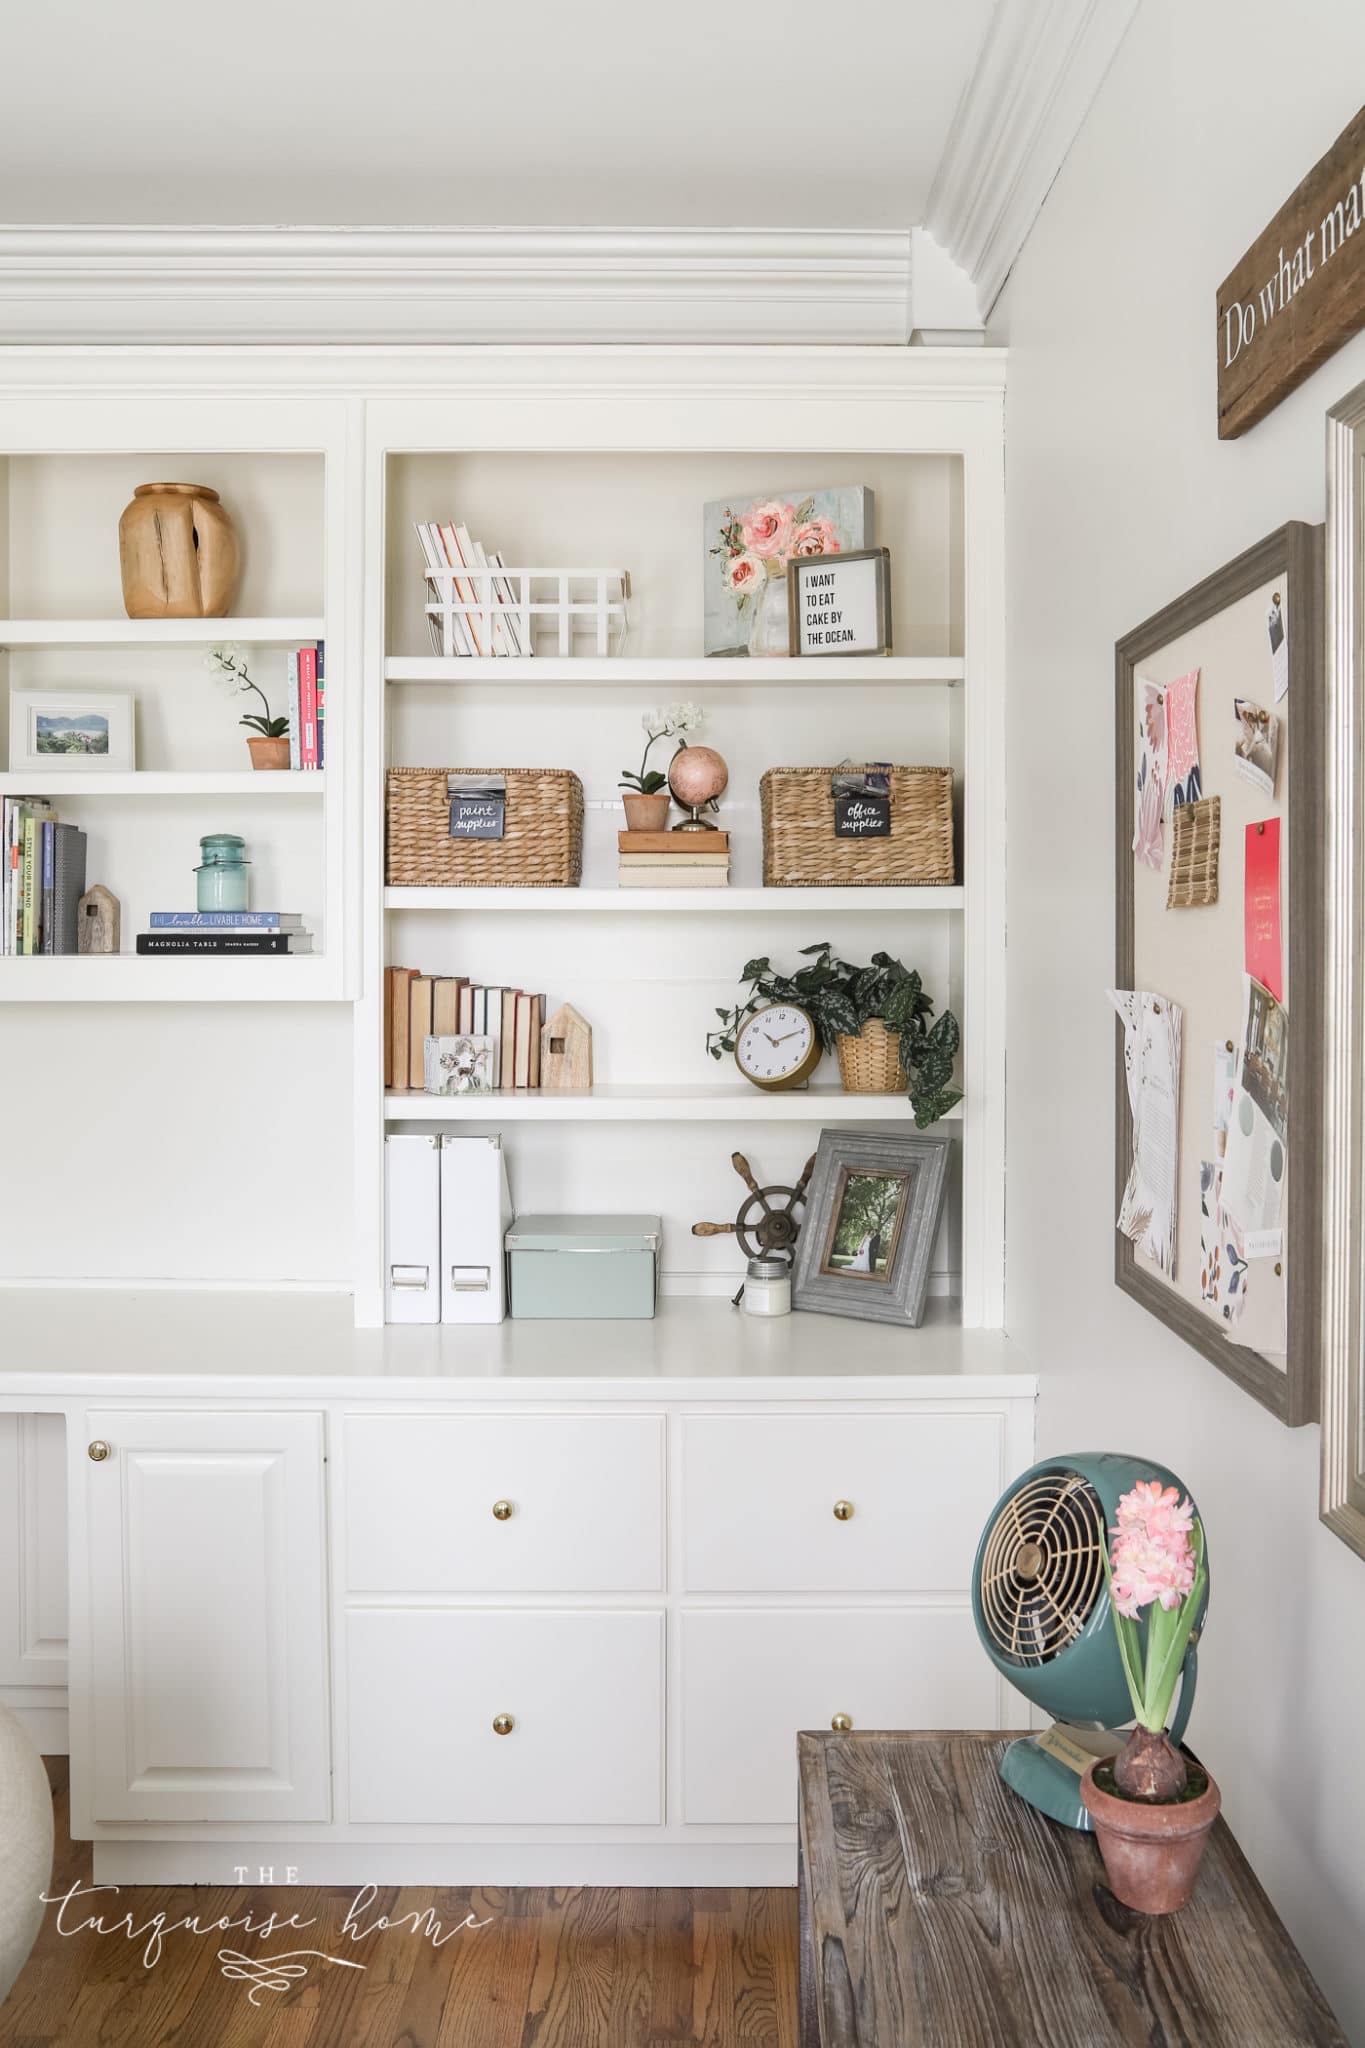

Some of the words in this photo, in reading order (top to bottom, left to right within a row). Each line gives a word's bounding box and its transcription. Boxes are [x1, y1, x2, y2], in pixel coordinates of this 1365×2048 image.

[1224, 302, 1255, 369] Do
[1258, 231, 1316, 327] what
[806, 576, 809, 588] I
[810, 573, 836, 588] WANT
[806, 595, 817, 607] TO
[819, 593, 836, 606] EAT
[806, 612, 829, 626] CAKE
[831, 611, 842, 624] BY
[807, 632, 824, 645] THE
[825, 629, 856, 644] OCEAN.
[460, 804, 496, 819] paint
[848, 802, 881, 819] office
[454, 818, 500, 832] supplies
[841, 818, 885, 832] supplies
[210, 914, 240, 926] LIVABLE
[241, 914, 263, 925] HOME
